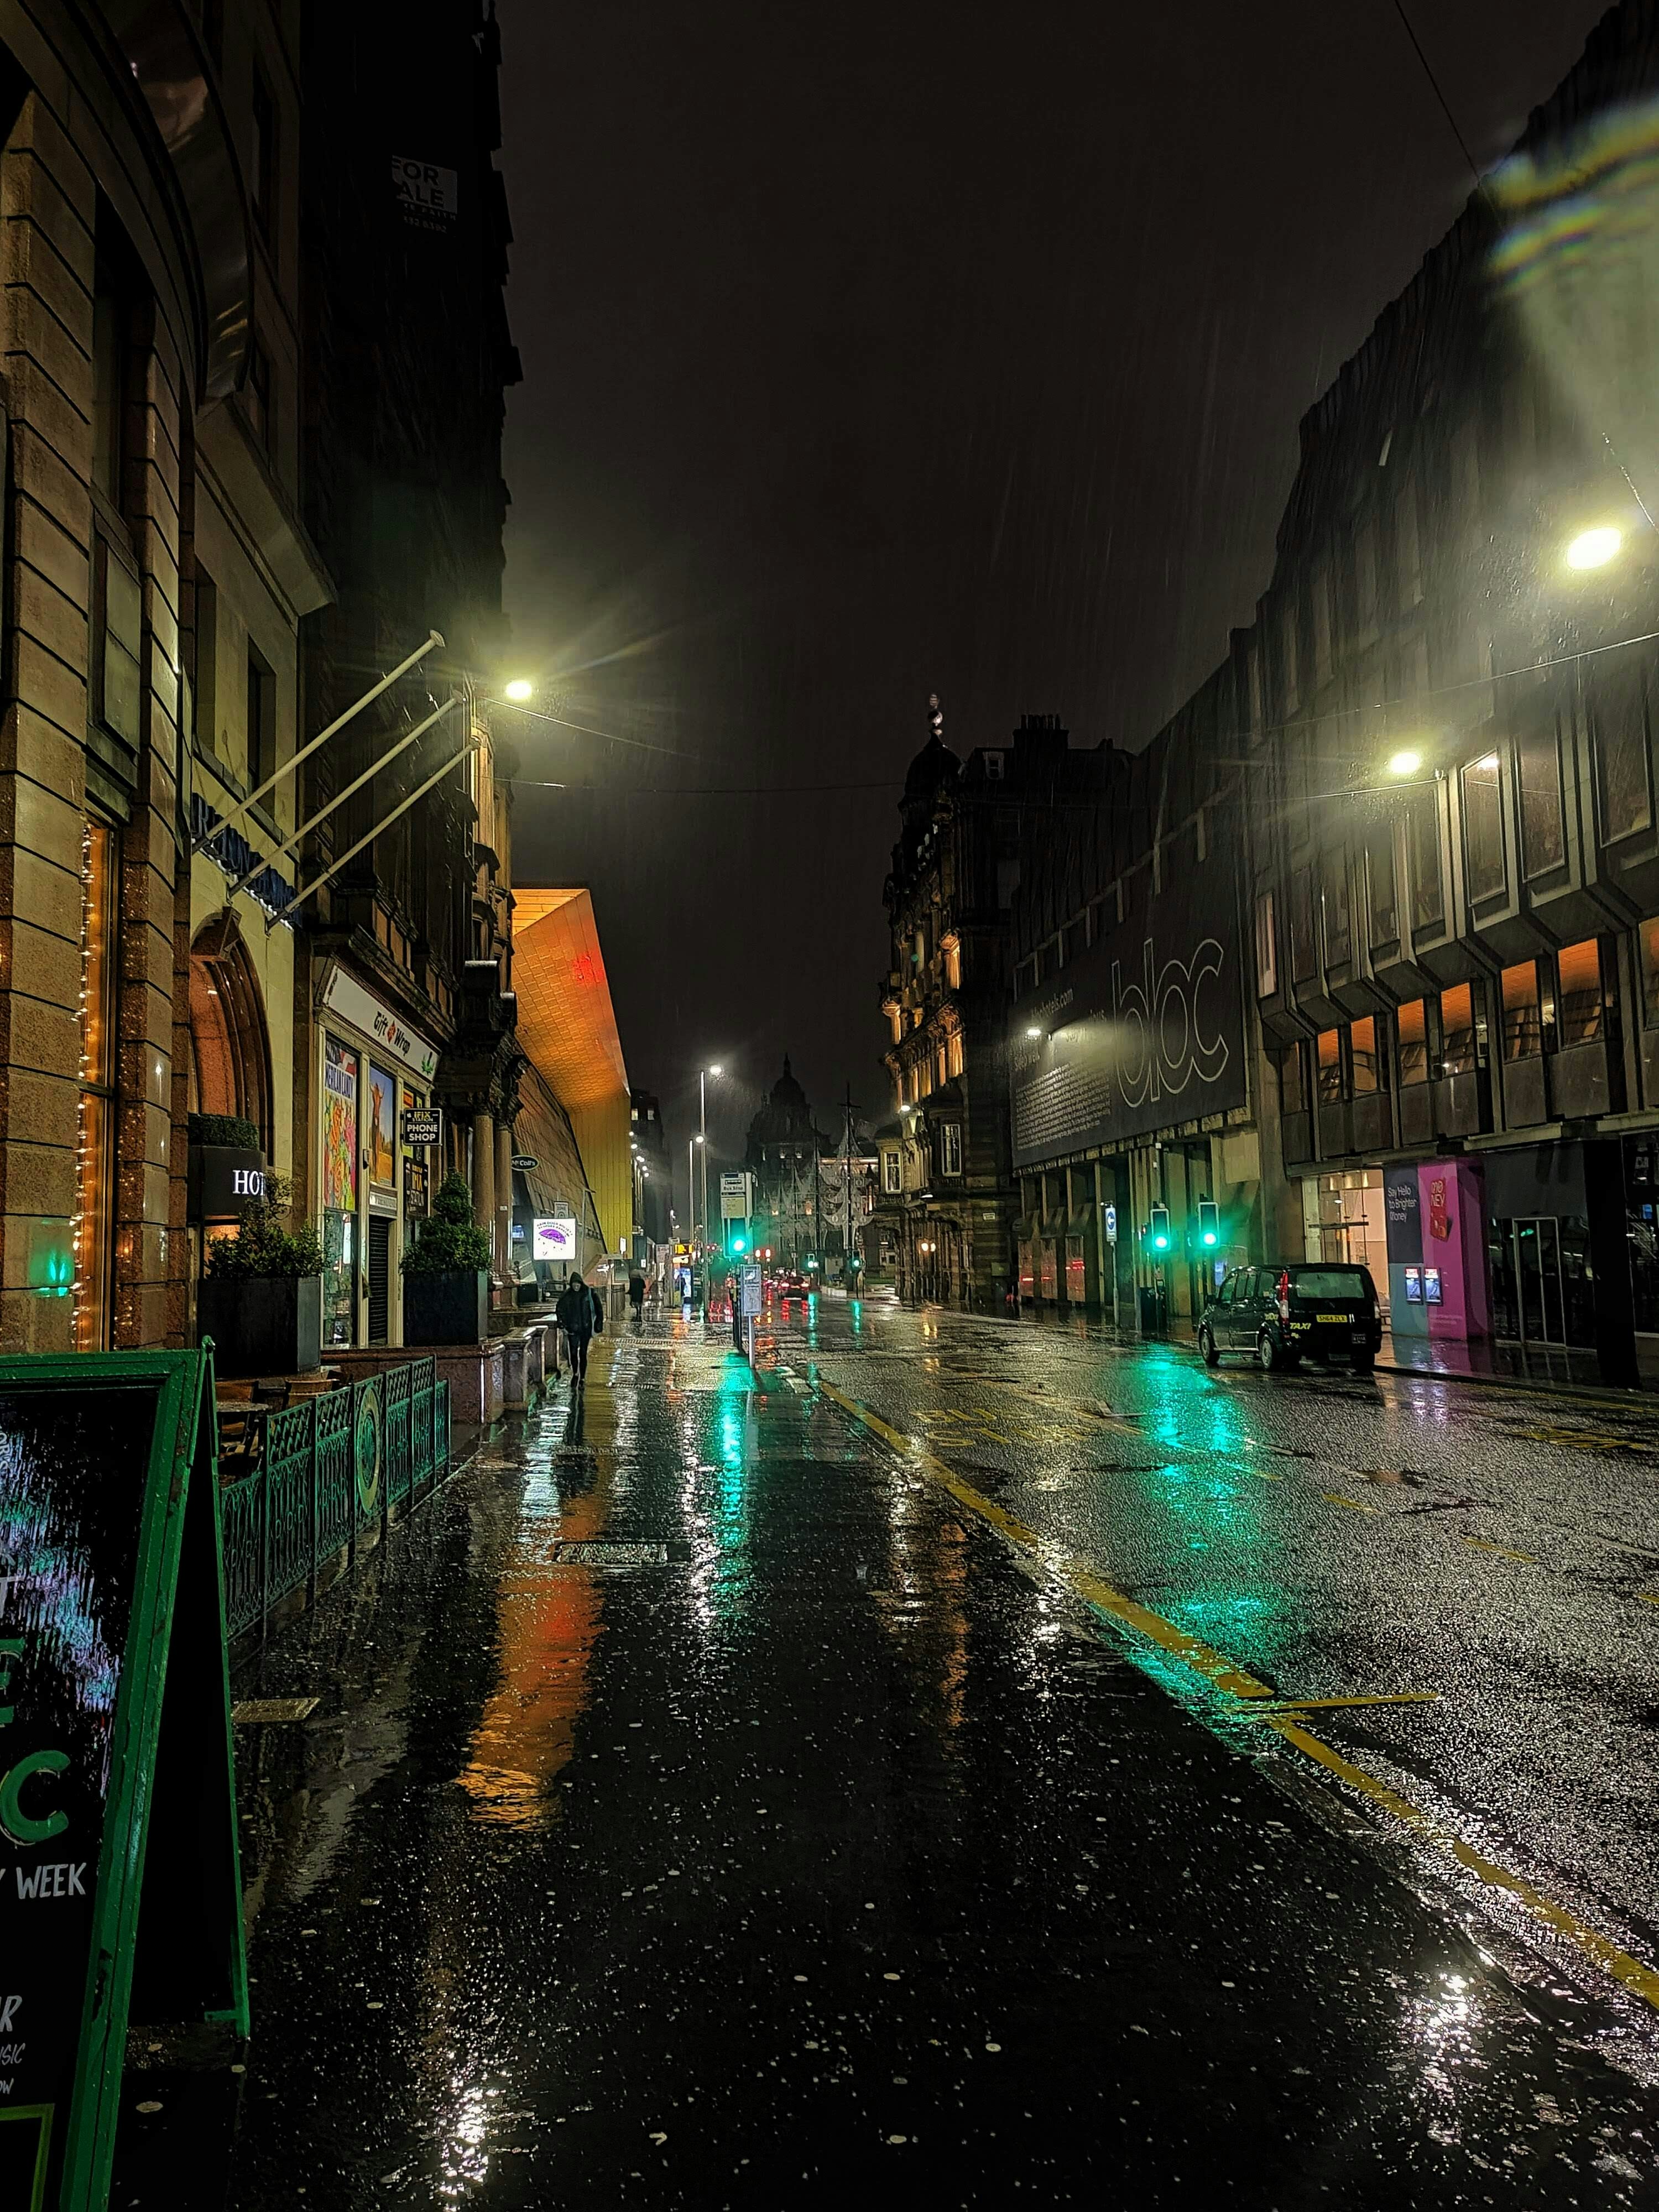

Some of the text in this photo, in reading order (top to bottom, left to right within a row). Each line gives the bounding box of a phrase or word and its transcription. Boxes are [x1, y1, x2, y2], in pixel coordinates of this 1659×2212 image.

[399, 181, 444, 208] ALE
[374, 1011, 410, 1056] Gift Wrap
[1111, 937, 1230, 1108] bloc
[407, 1124, 438, 1133] PHONE
[409, 1133, 436, 1141] SHOP
[1387, 1185, 1411, 1198] Say Hello
[1389, 1199, 1395, 1209] to
[15, 1862, 87, 1900] WEEK
[0, 1995, 23, 2032] R
[0, 2042, 26, 2066] SIC
